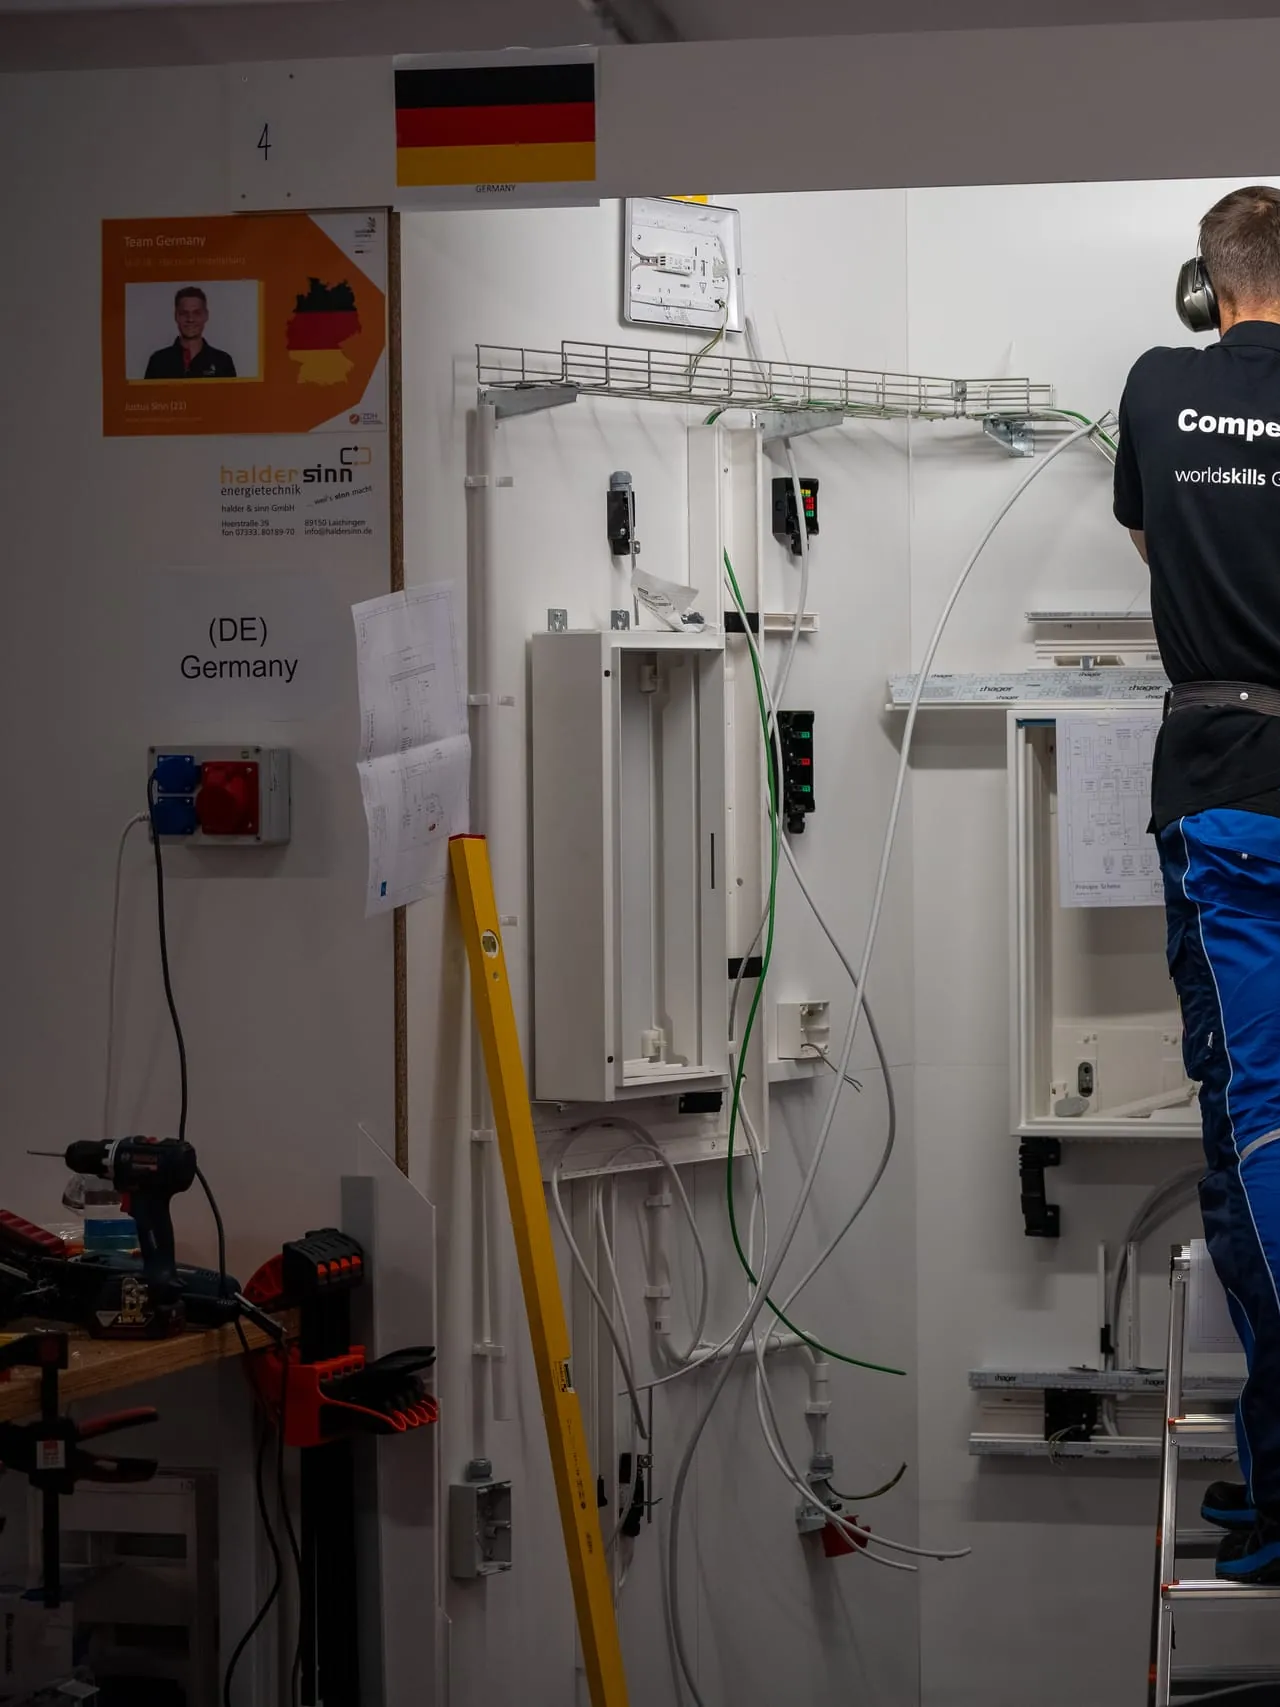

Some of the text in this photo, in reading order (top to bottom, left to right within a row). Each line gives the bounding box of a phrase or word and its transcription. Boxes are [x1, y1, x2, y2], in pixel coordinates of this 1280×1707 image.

[257, 123, 272, 161] 4
[476, 184, 516, 193] GERMANY
[124, 234, 206, 248] Team Germany
[220, 464, 352, 484] halder sinn
[1175, 467, 1267, 487] worldskills
[220, 484, 301, 498] energietechnik
[221, 505, 244, 513] halder
[254, 504, 269, 512] sinn
[271, 504, 295, 512] GmbH
[328, 519, 366, 529] Laichingen
[209, 617, 267, 648] (DE)
[180, 655, 298, 683] Germany
